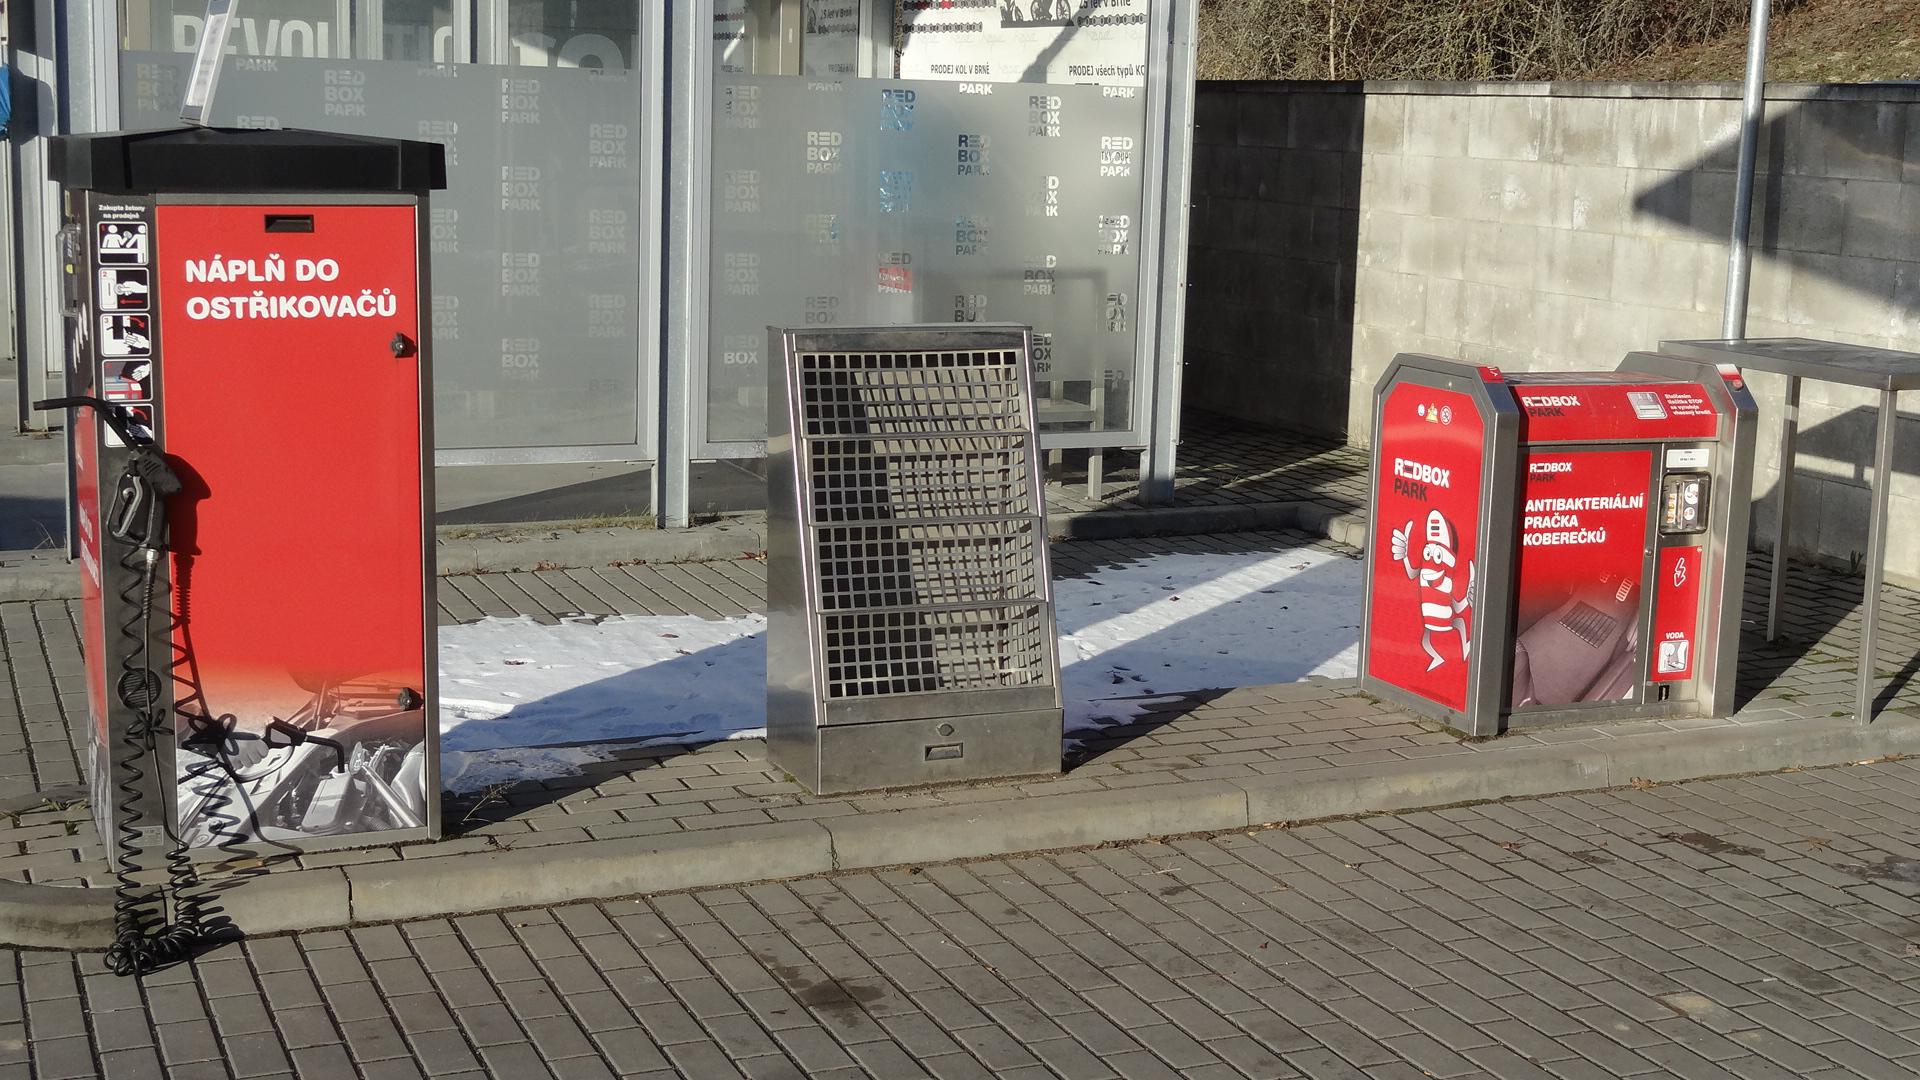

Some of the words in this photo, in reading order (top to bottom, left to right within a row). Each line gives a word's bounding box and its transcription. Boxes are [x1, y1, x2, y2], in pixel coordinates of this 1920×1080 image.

[931, 64, 953, 75] PRODEJ
[956, 64, 968, 75] KOL
[969, 64, 974, 75] V
[1069, 64, 1094, 76] PRODEJ
[1095, 63, 1116, 76] všech
[1117, 62, 1134, 79] typů
[324, 70, 366, 86] RED
[324, 86, 366, 102] BOX
[959, 83, 993, 95] PARK
[1102, 86, 1135, 99] PARK
[325, 103, 367, 117] PARK
[1028, 95, 1062, 111] RED
[1028, 111, 1061, 125] BOX
[588, 124, 628, 140] RED
[807, 131, 842, 146] RED
[1028, 126, 1061, 138] PARK
[588, 140, 626, 155] BOX
[958, 134, 991, 149] RED
[1101, 136, 1134, 150] RED
[807, 147, 841, 161] BOX
[957, 149, 990, 163] BOX
[588, 156, 627, 169] PARK
[1100, 165, 1131, 177] PARK
[432, 208, 459, 223] ED
[431, 224, 458, 240] OX
[431, 240, 459, 253] ARK
[501, 252, 541, 267] RED
[185, 253, 286, 283] NÁPLŇ
[295, 258, 340, 282] DO
[1024, 284, 1056, 296] PARK
[186, 288, 397, 320] OSTŘIKOVAČŮ
[432, 295, 460, 310] ED
[432, 311, 458, 326] OX
[432, 327, 460, 340] ARK
[1033, 334, 1052, 347] ED
[501, 354, 540, 368] BOX
[723, 351, 758, 365] BOX
[1033, 348, 1052, 362] OX
[1522, 394, 1581, 407] REDBOX
[1527, 406, 1565, 417] PARK
[1394, 457, 1450, 488] REDBOX
[1529, 462, 1572, 473] REDBOX
[1529, 473, 1556, 482] PARK
[1394, 478, 1428, 502] PARK
[1525, 492, 1644, 512] ANTIBAKTERIÁLNÍ
[1524, 512, 1579, 529] PRAČKA
[1523, 526, 1606, 546] KOBEREČKŮ
